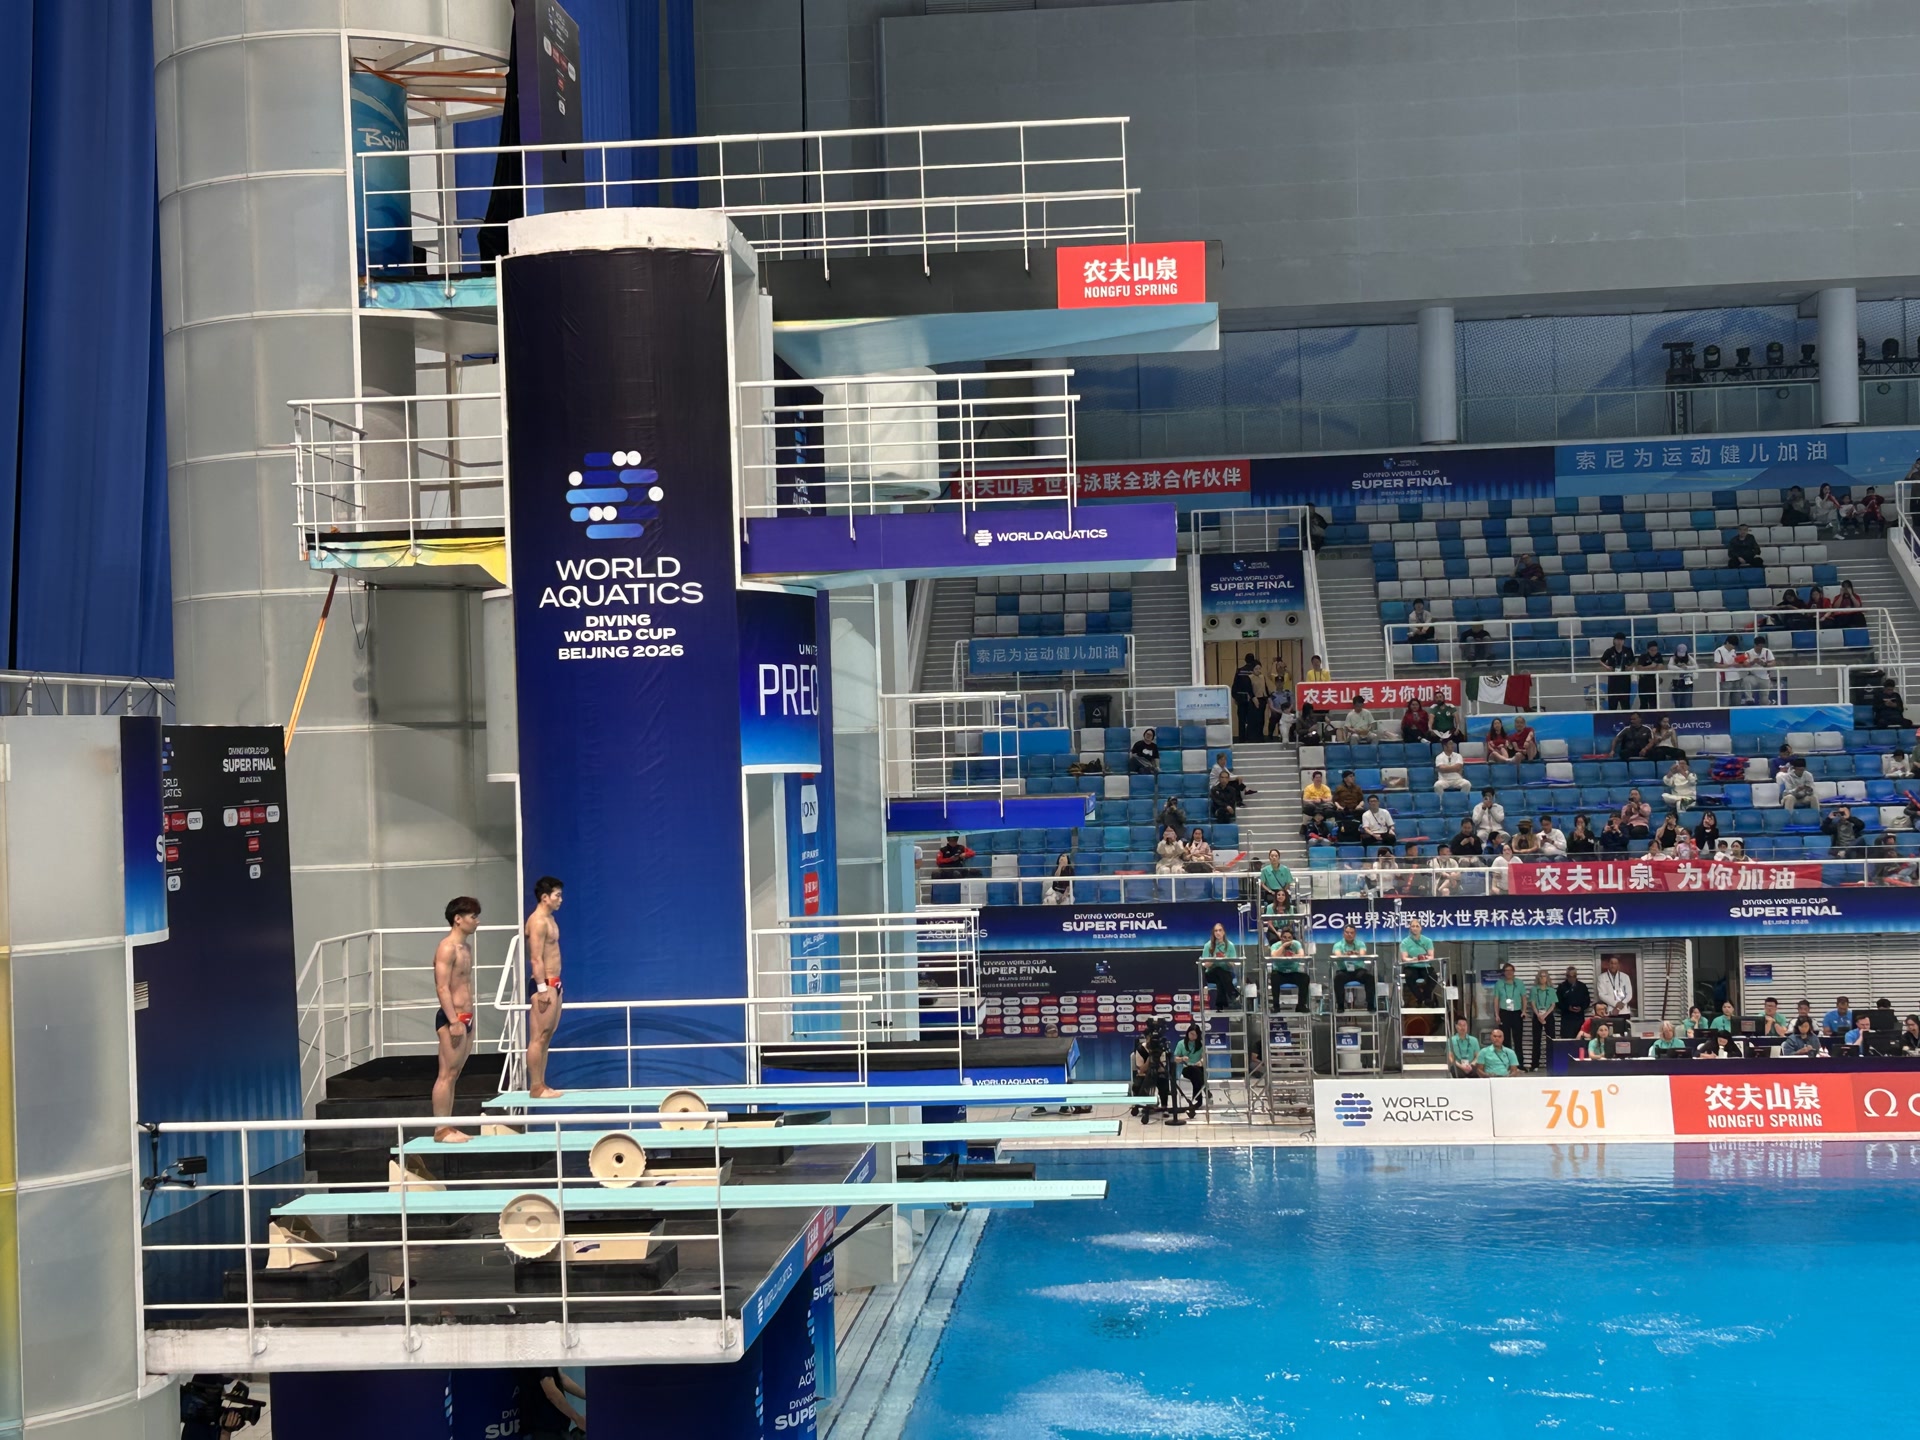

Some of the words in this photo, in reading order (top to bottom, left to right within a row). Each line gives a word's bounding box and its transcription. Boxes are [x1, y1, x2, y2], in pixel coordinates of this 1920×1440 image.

[1083, 256, 1178, 283] 农夫山泉
[1084, 285, 1130, 298] NONGFU
[1135, 283, 1178, 297] SPRING
[1575, 441, 1828, 470] 索尼为运动健儿加油
[1352, 479, 1404, 490] SUPER
[1407, 477, 1452, 487] FINAL
[997, 532, 1044, 542] WORLD
[1044, 528, 1108, 541] AQUATICS
[556, 557, 681, 581] WORLD
[1211, 582, 1254, 592] SUPER
[1257, 580, 1294, 590] FINAL
[539, 582, 704, 609] AQUATICS
[586, 613, 651, 628] DIVING
[564, 629, 632, 642] WORLD
[635, 628, 676, 640] CUP
[558, 646, 629, 660] BEIJING
[632, 644, 684, 658] 2026
[976, 645, 1119, 664] 索尼为运动健儿加油
[1303, 687, 1375, 704] 农夫山泉
[1668, 722, 1712, 730] QUATICS
[223, 758, 251, 772] SUPER
[253, 758, 276, 771] FINAL
[1535, 863, 1655, 892] 农夫山泉
[1677, 863, 1796, 890] 为你加油
[1729, 906, 1788, 918] SUPER
[1791, 905, 1842, 916] FINAL
[1062, 921, 1117, 932] SUPER
[1119, 920, 1167, 930] FINAL
[1019, 965, 1057, 975] FINAL
[1382, 1097, 1449, 1108] WORLD
[1705, 1082, 1821, 1111] 农夫山泉
[1541, 1083, 1619, 1129] 361°
[1383, 1110, 1474, 1122] AQUATICS
[1708, 1114, 1764, 1128] NONGFU
[1770, 1113, 1822, 1127] SPRING
